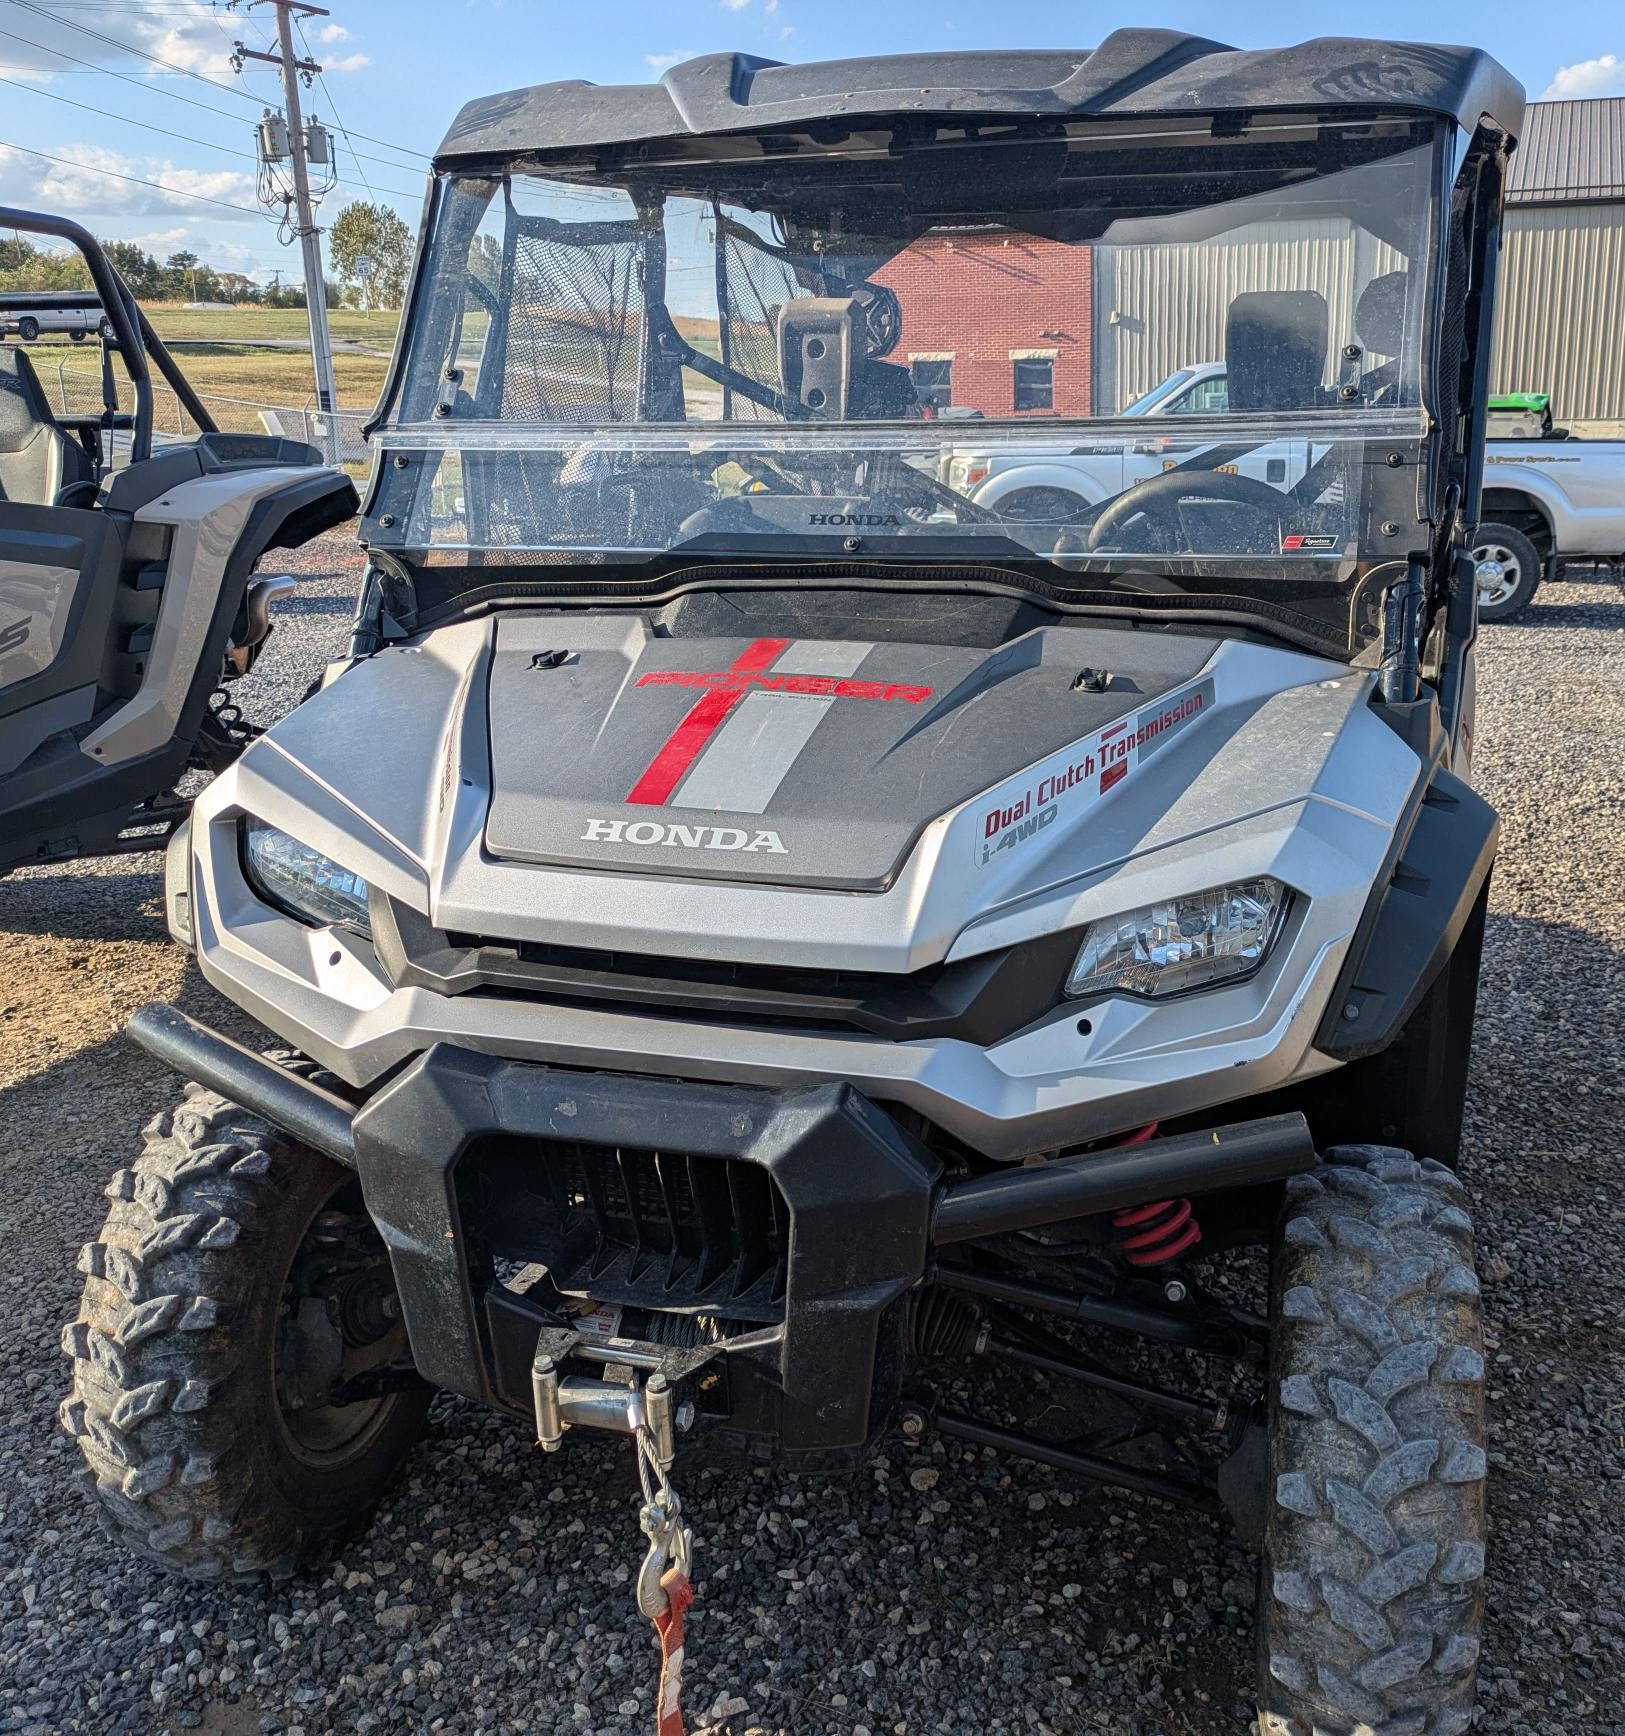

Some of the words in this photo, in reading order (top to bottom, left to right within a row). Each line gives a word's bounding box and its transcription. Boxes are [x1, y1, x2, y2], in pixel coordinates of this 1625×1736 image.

[358, 266, 369, 274] 65
[808, 514, 902, 526] HONDA
[634, 672, 933, 704] PIONEER
[984, 791, 1031, 839] Dual
[1037, 755, 1095, 807] Clutch
[1098, 693, 1203, 768] Transmission
[581, 819, 789, 854] HONDA
[982, 803, 1058, 866] i-4WD
